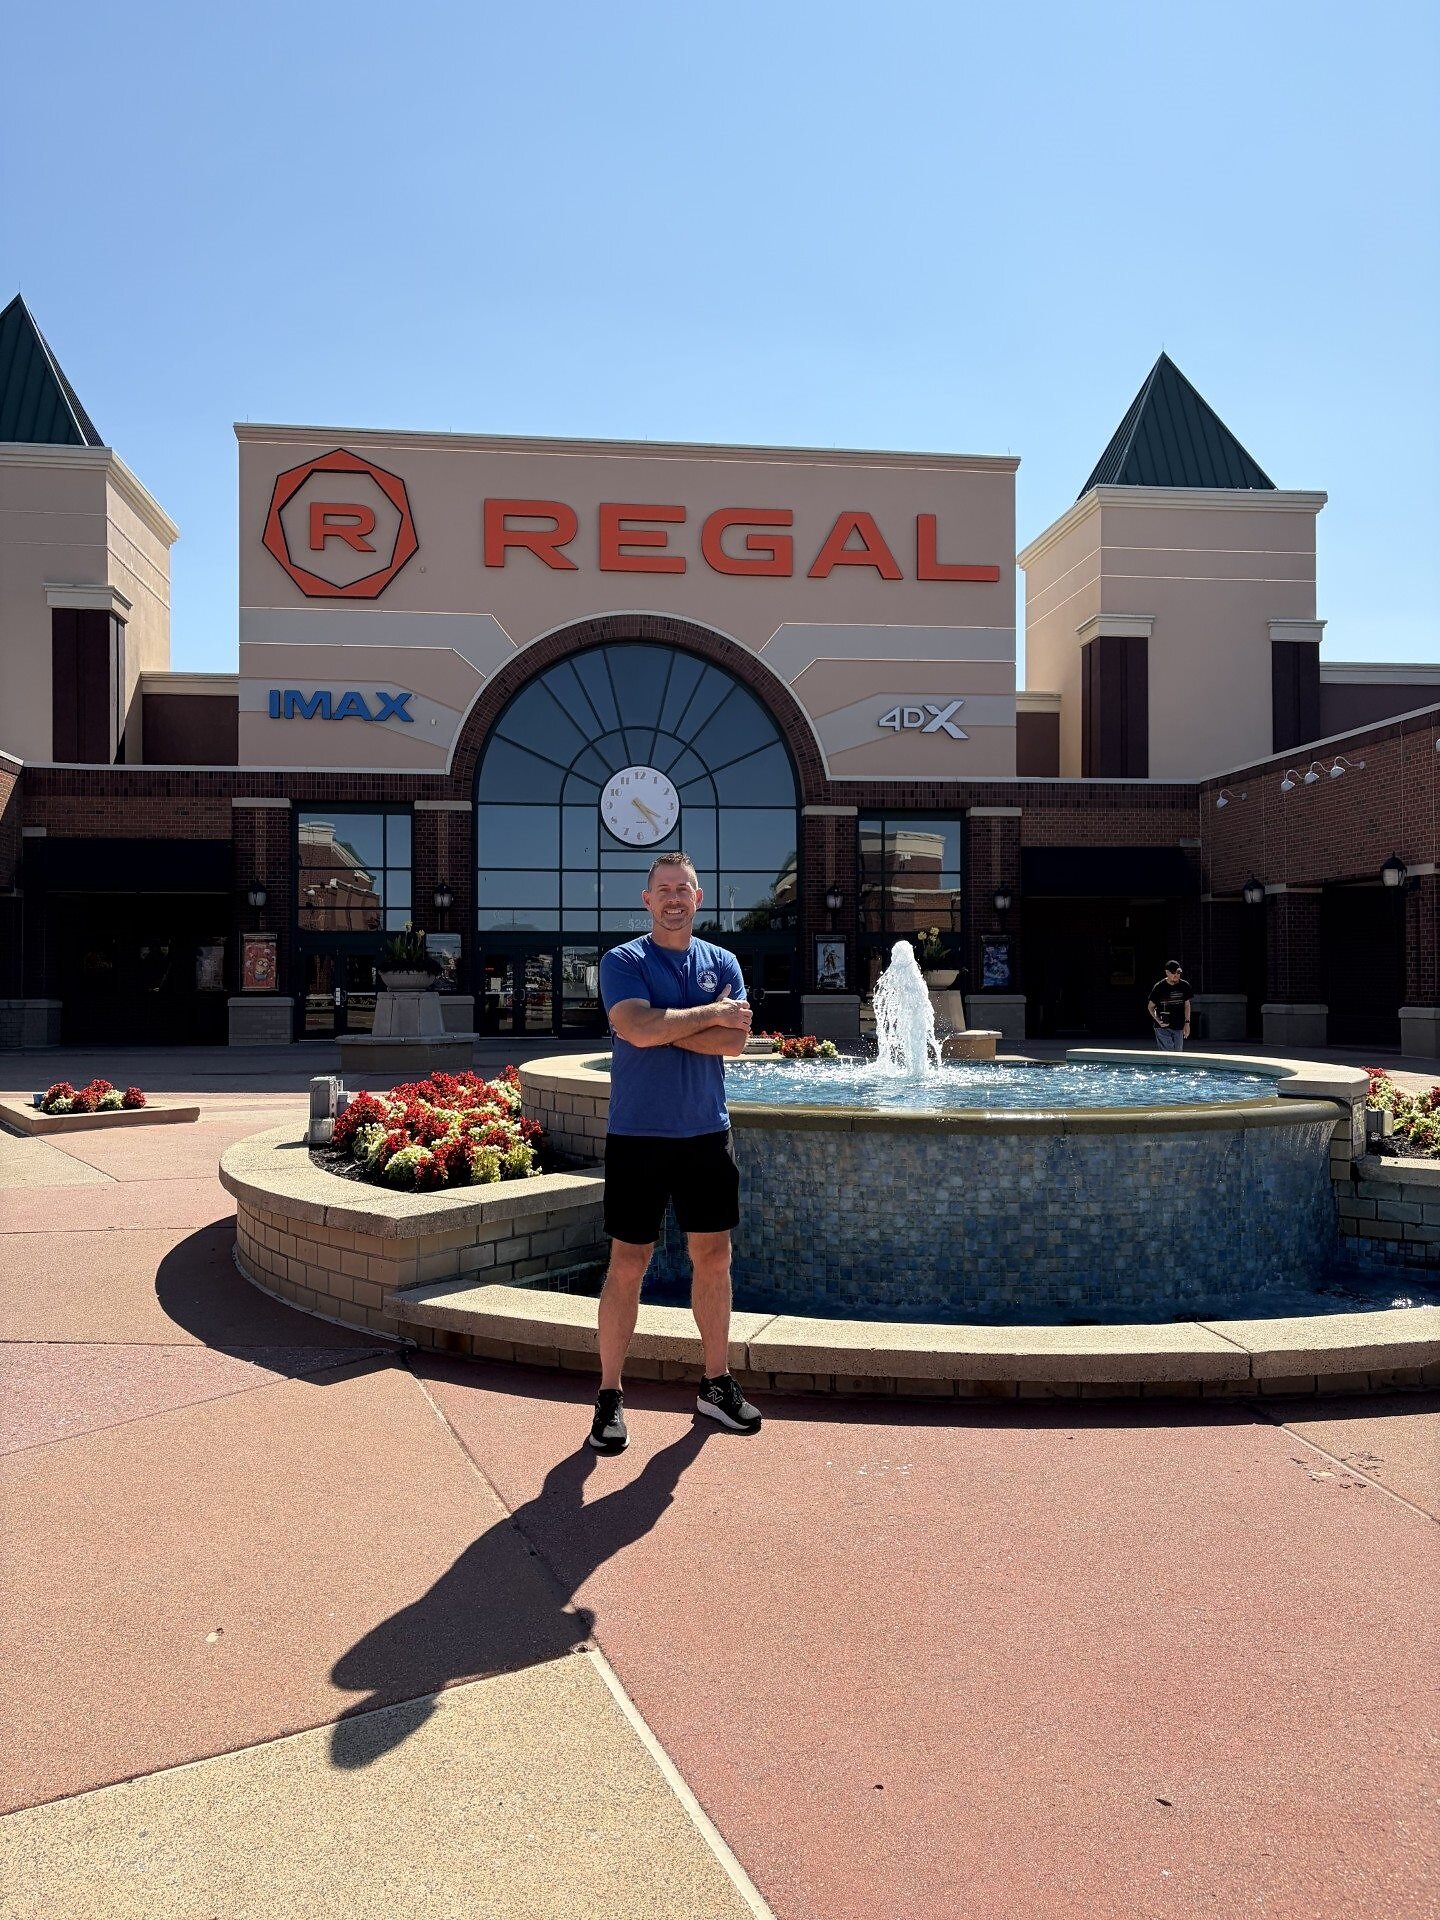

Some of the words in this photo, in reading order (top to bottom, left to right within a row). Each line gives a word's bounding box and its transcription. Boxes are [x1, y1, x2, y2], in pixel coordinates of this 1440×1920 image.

[309, 502, 377, 553] R
[484, 498, 1000, 582] REGAL
[269, 689, 415, 723] IMAX
[878, 700, 969, 739] 4DX
[620, 776, 630, 785] 11
[634, 771, 647, 780] 12
